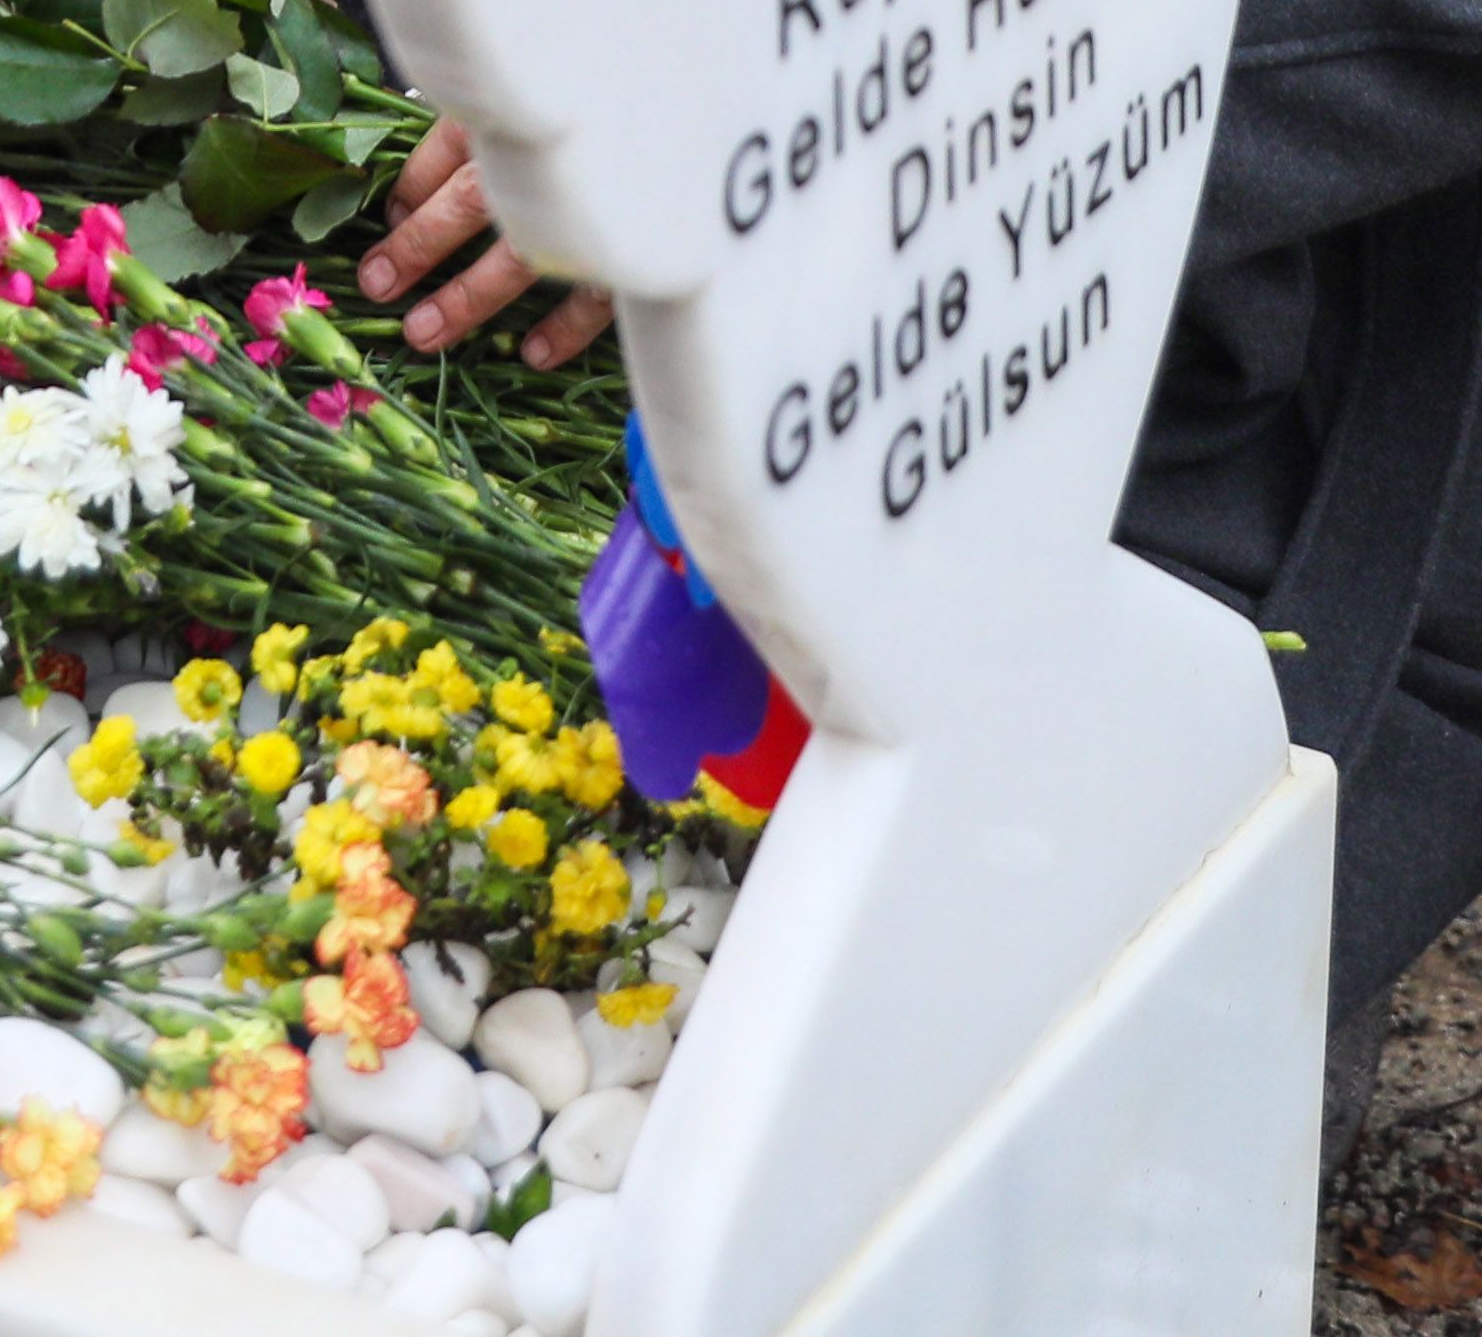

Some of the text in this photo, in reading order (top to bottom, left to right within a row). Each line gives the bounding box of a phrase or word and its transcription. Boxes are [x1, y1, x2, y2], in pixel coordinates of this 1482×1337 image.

[722, 25, 936, 239] Gelde
[889, 27, 1098, 255] Dinsin
[763, 62, 1206, 490] Gelde Yüzüm
[879, 271, 1112, 523] Gülsun
